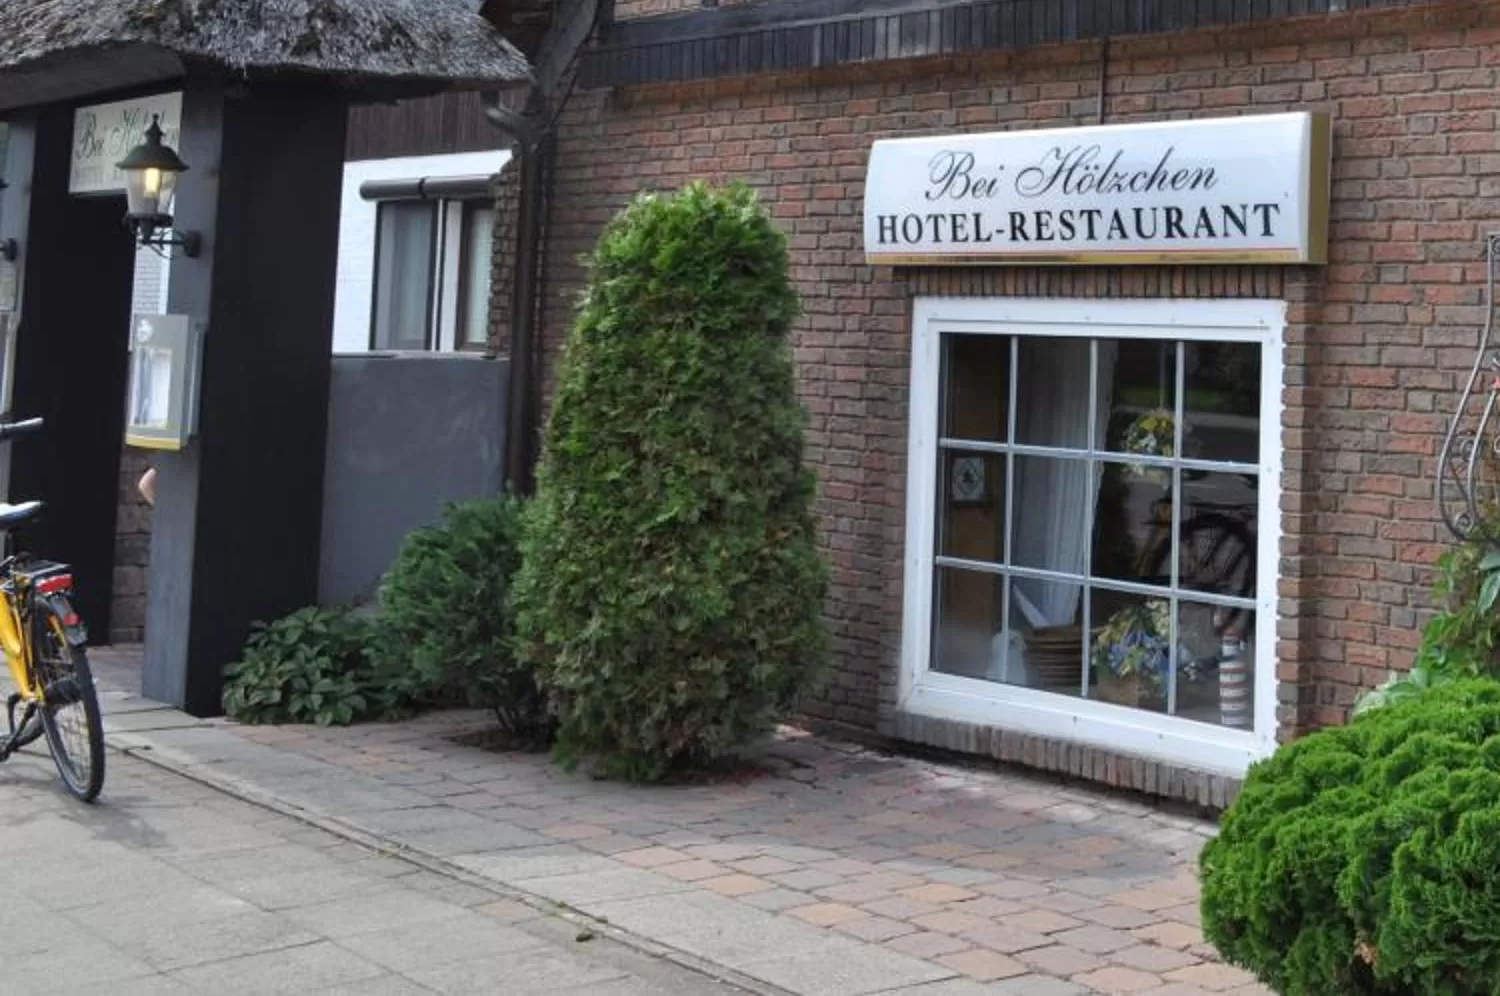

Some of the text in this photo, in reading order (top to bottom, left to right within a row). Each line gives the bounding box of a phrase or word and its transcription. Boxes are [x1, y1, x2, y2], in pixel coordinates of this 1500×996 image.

[924, 144, 1218, 200] Bei Hölzchen
[877, 203, 1280, 244] HOTEL-RESTAURANT
